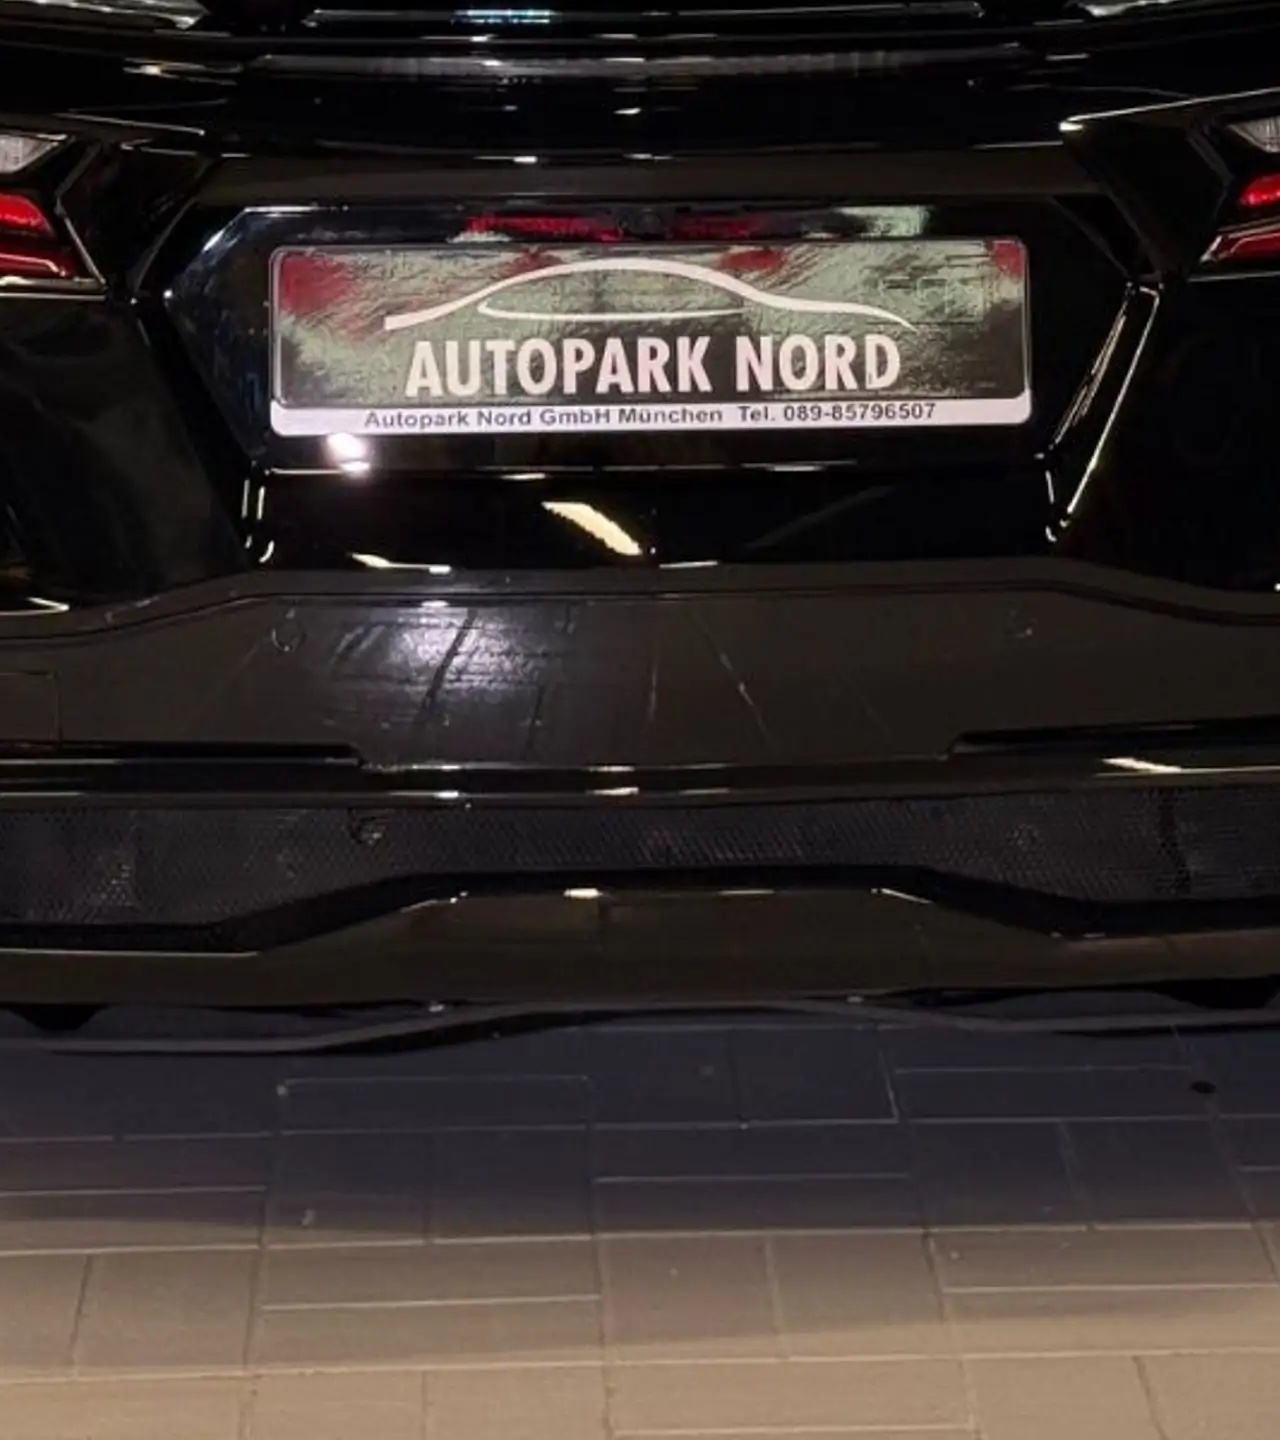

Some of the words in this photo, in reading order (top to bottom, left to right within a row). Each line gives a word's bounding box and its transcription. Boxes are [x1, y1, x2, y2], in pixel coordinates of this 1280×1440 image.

[404, 337, 713, 397] AUTOPARK
[735, 334, 901, 392] NORD
[365, 411, 470, 432] Autopark
[477, 409, 532, 427] Nord
[539, 407, 611, 425] GmbH
[618, 406, 723, 425] München
[738, 405, 776, 422] Tel.
[784, 403, 937, 422] 089-85796507
